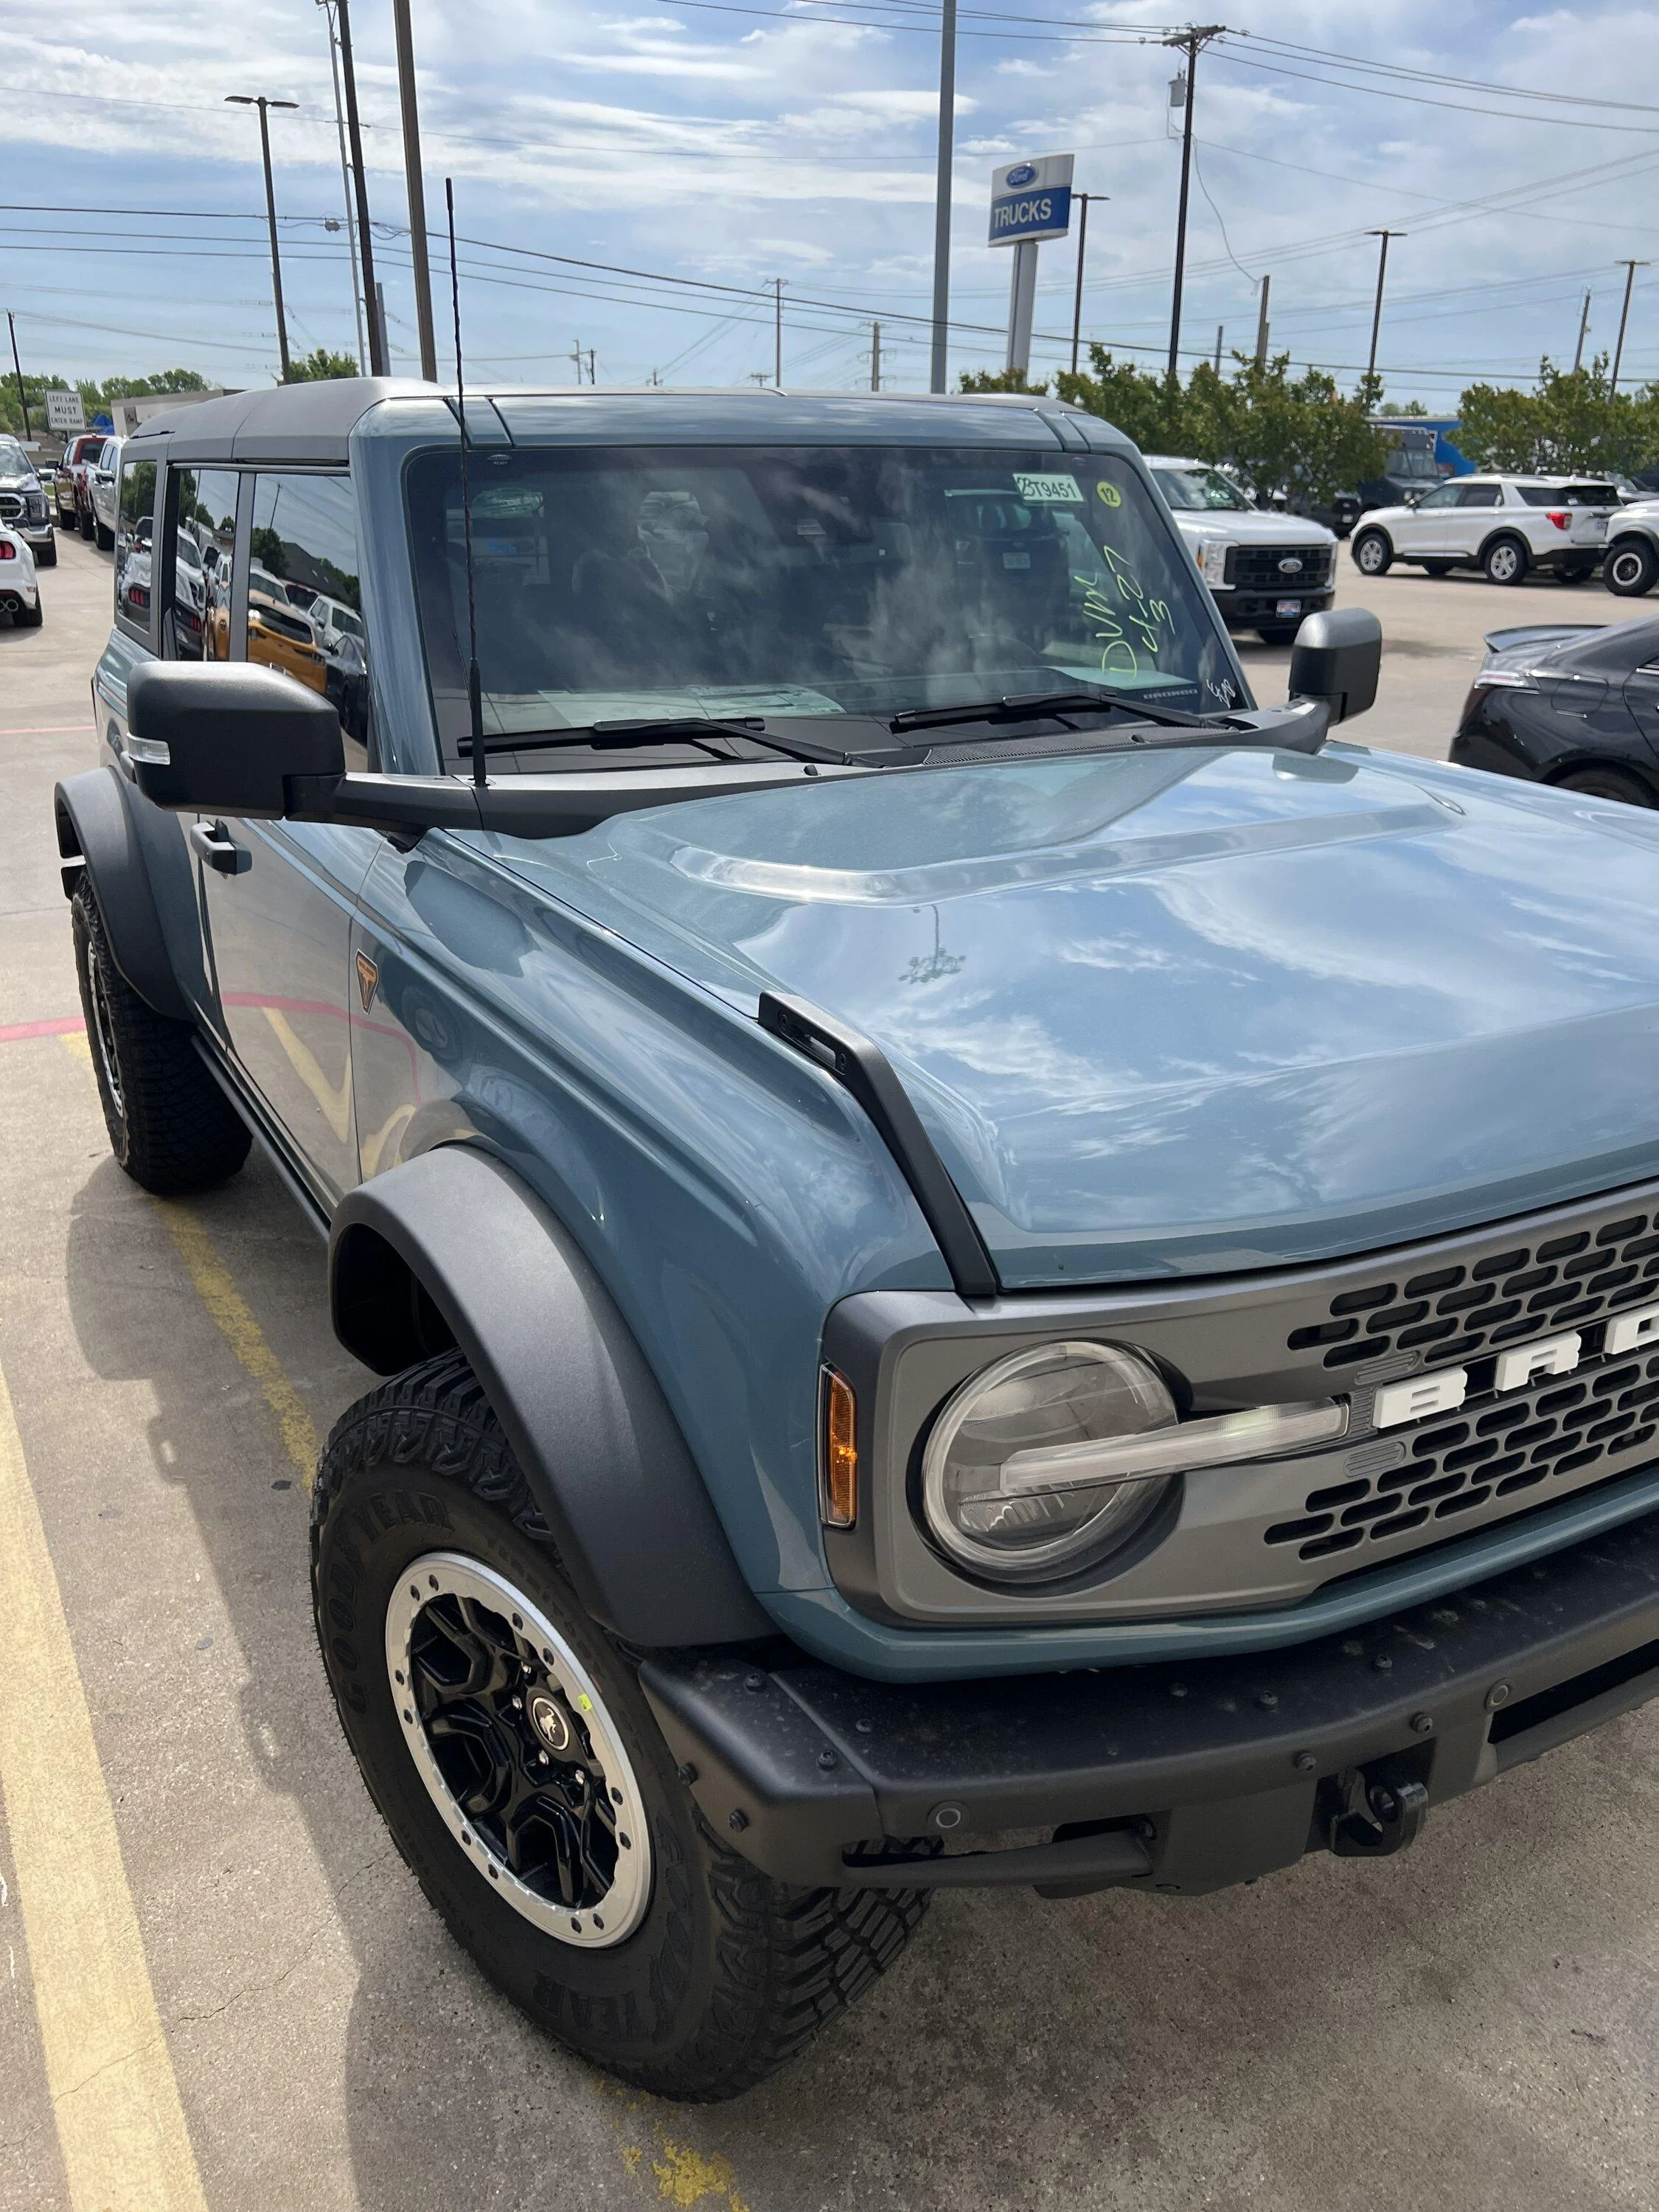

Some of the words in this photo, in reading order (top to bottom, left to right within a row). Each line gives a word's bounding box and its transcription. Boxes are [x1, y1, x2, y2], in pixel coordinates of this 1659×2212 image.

[993, 198, 1052, 229] TRUCKS
[65, 396, 79, 404] LANE
[55, 406, 77, 415] MUST
[1101, 487, 1118, 503] 12
